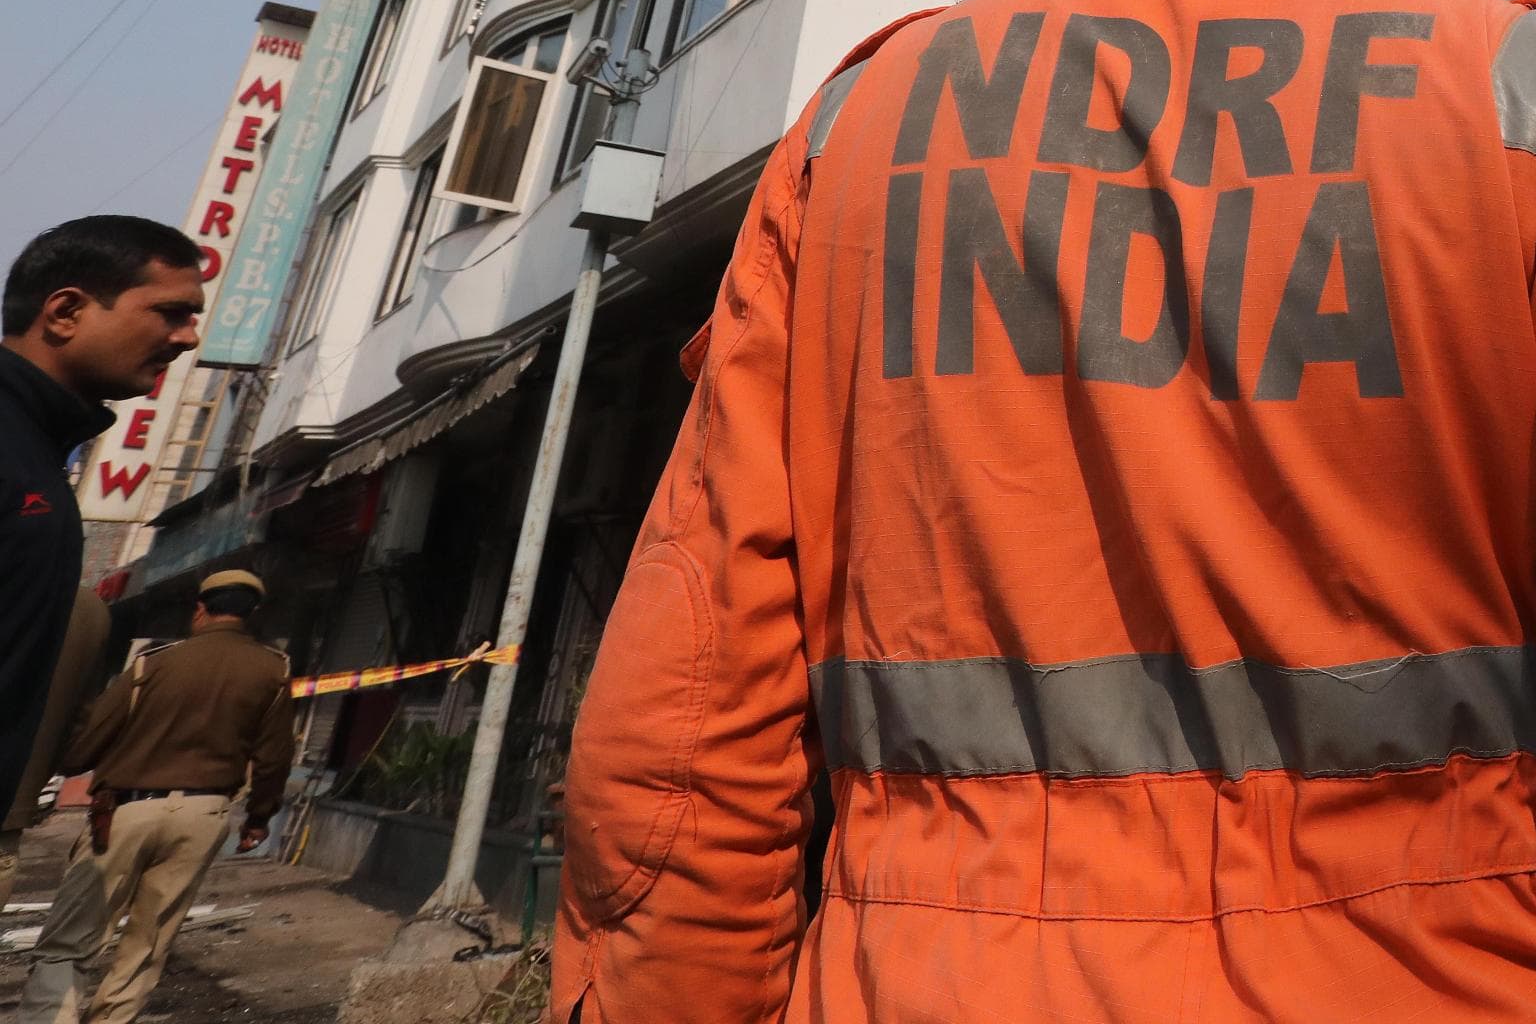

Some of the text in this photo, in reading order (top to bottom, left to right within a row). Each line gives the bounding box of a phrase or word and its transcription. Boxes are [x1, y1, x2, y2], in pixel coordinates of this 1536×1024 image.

[200, 77, 282, 284] METRO
[892, 10, 1436, 187] NDRF
[220, 295, 272, 330] 87
[882, 166, 1405, 402] INDIA
